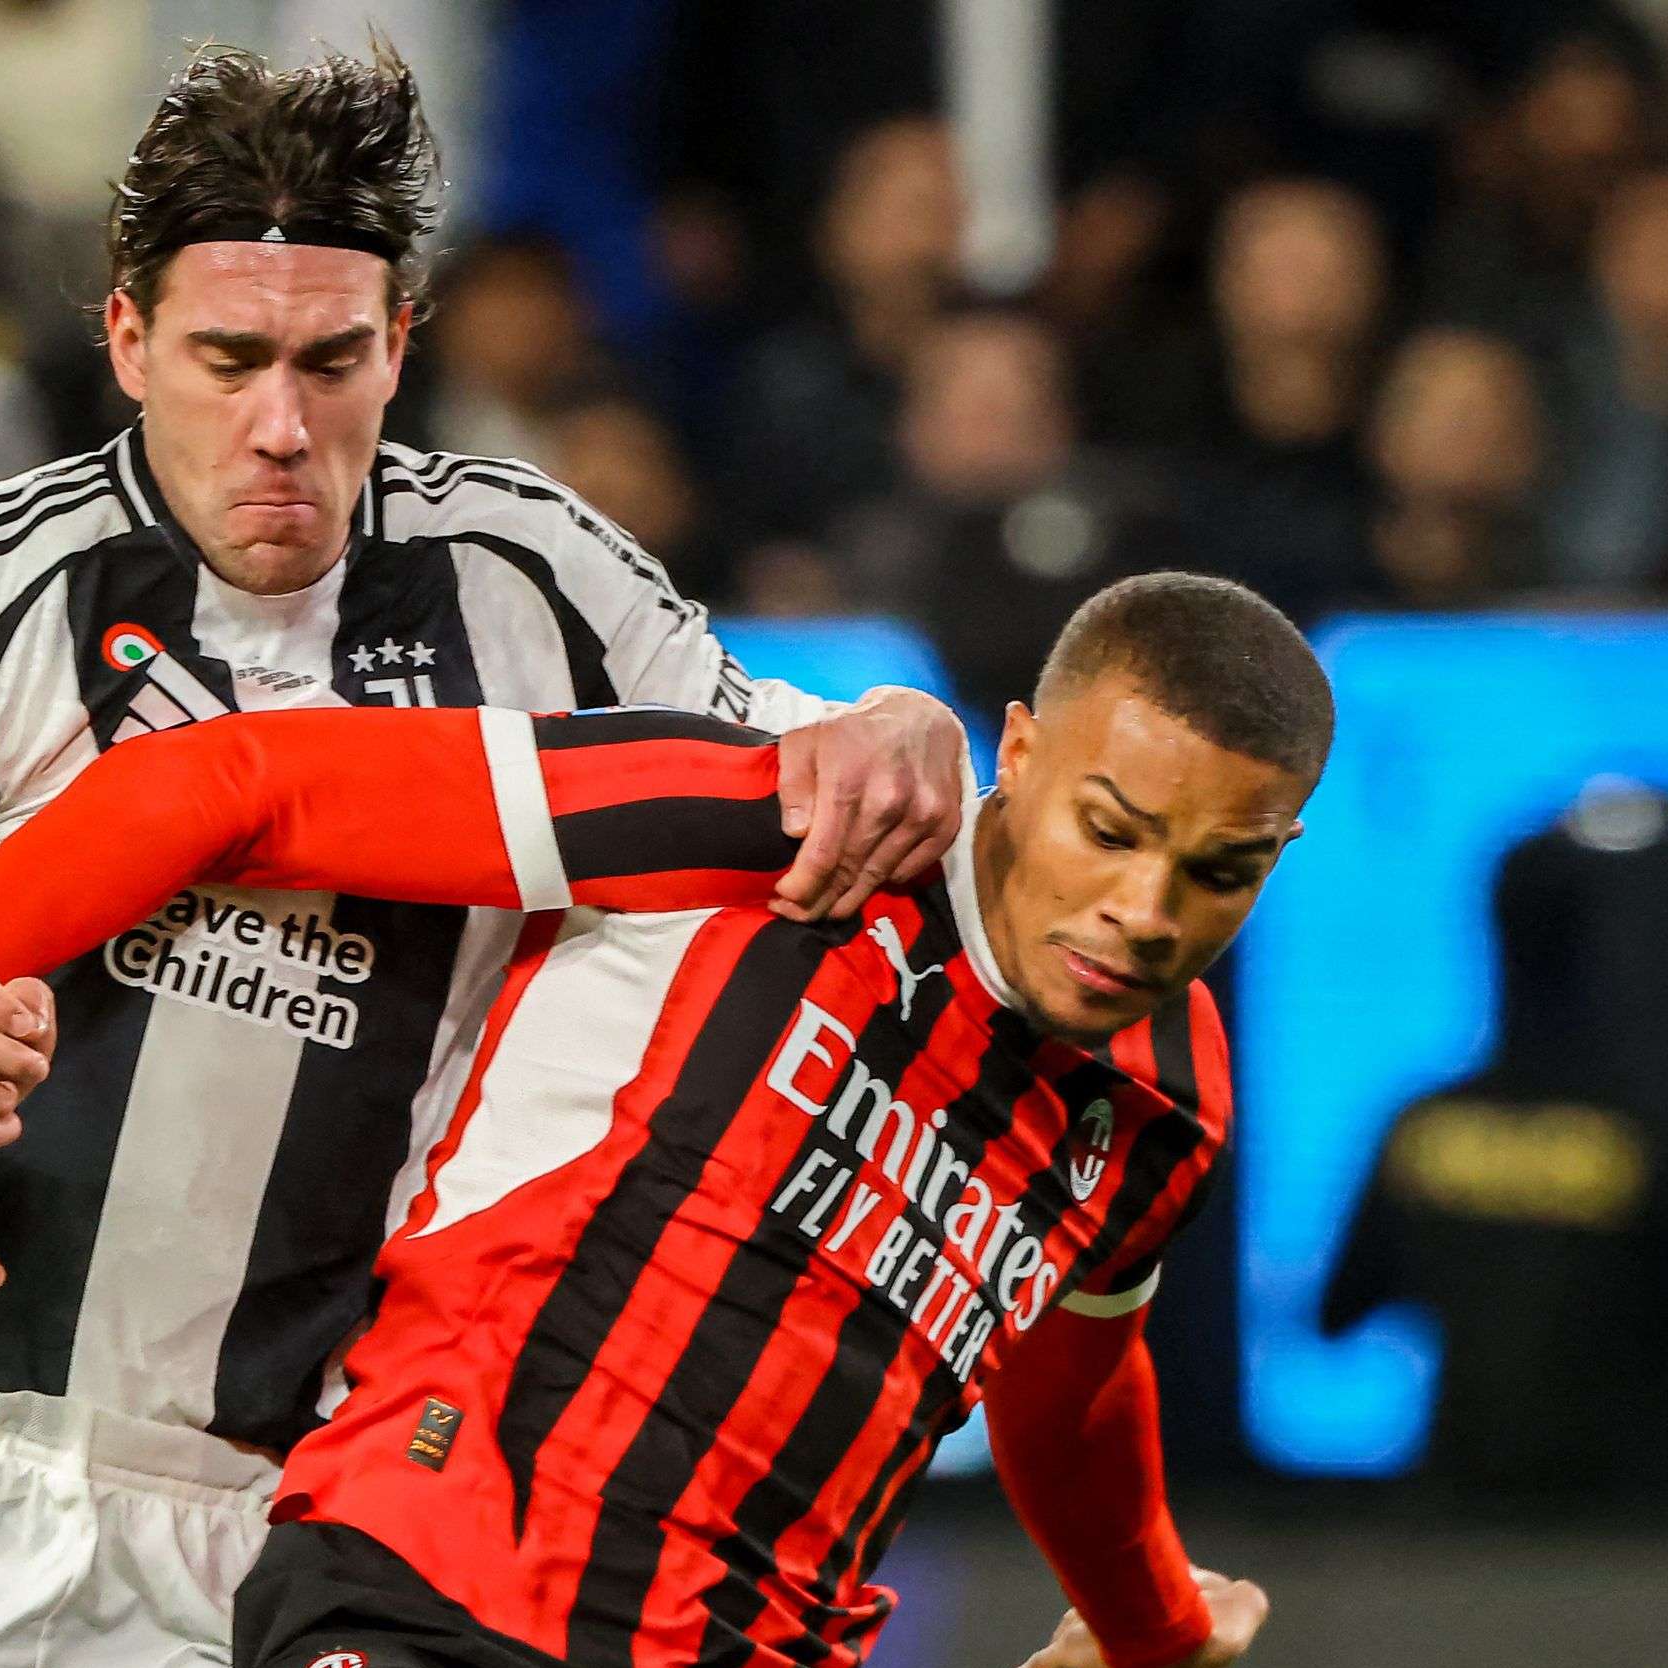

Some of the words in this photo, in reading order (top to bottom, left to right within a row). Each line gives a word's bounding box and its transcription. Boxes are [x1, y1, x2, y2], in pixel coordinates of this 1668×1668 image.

[114, 928, 350, 1041] Children
[144, 888, 266, 946] ave
[280, 913, 367, 976] the
[766, 998, 1057, 1332] Emirates
[772, 1148, 883, 1252] FLY
[865, 1214, 996, 1383] BETTER
